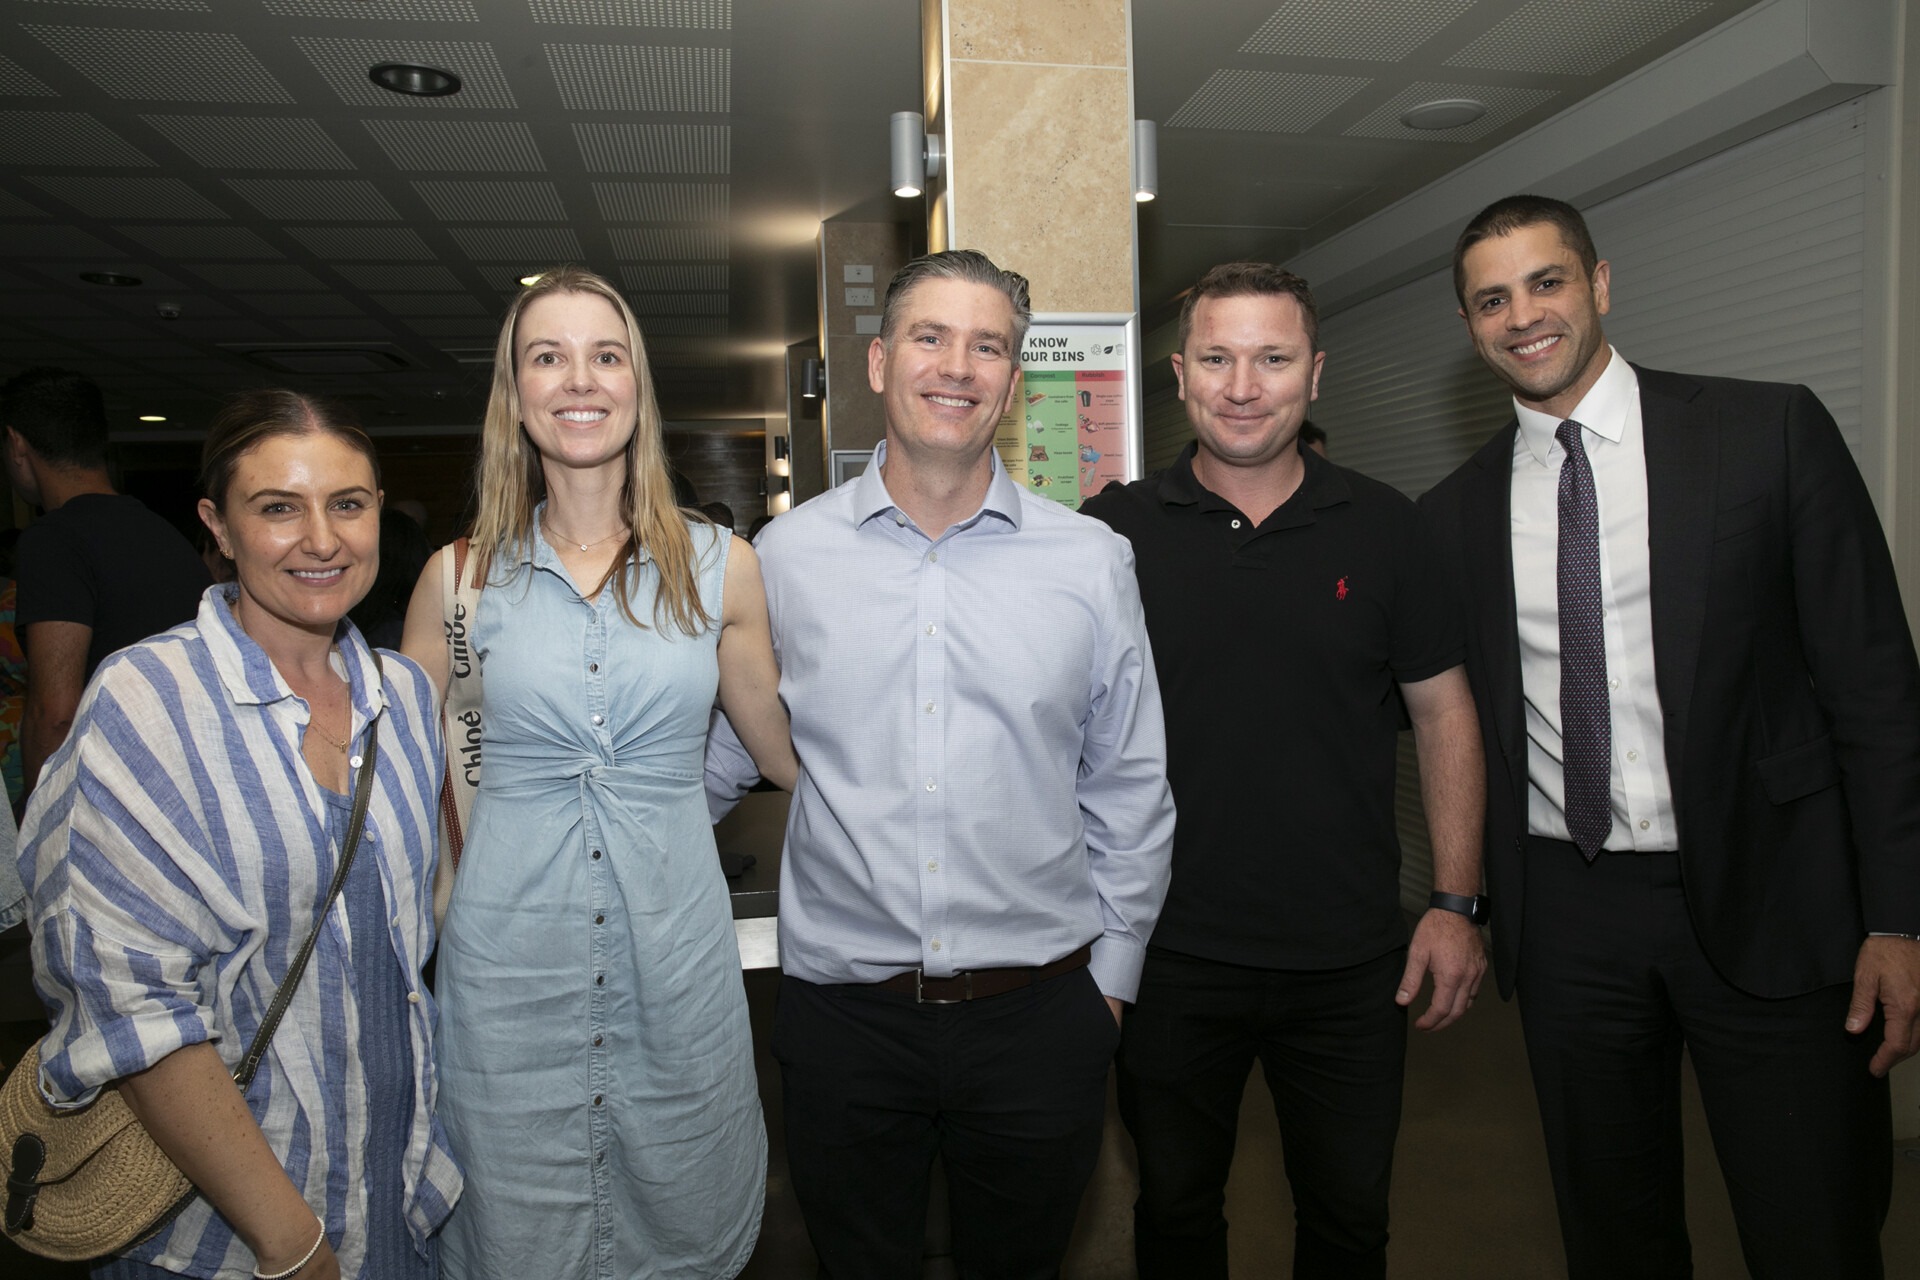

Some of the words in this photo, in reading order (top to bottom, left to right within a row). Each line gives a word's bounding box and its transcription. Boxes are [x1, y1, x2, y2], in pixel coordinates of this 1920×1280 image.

[1029, 337, 1068, 348] KNOW
[1021, 351, 1048, 362] OUR
[1052, 351, 1085, 362] BINS
[457, 710, 482, 788] Chloé
